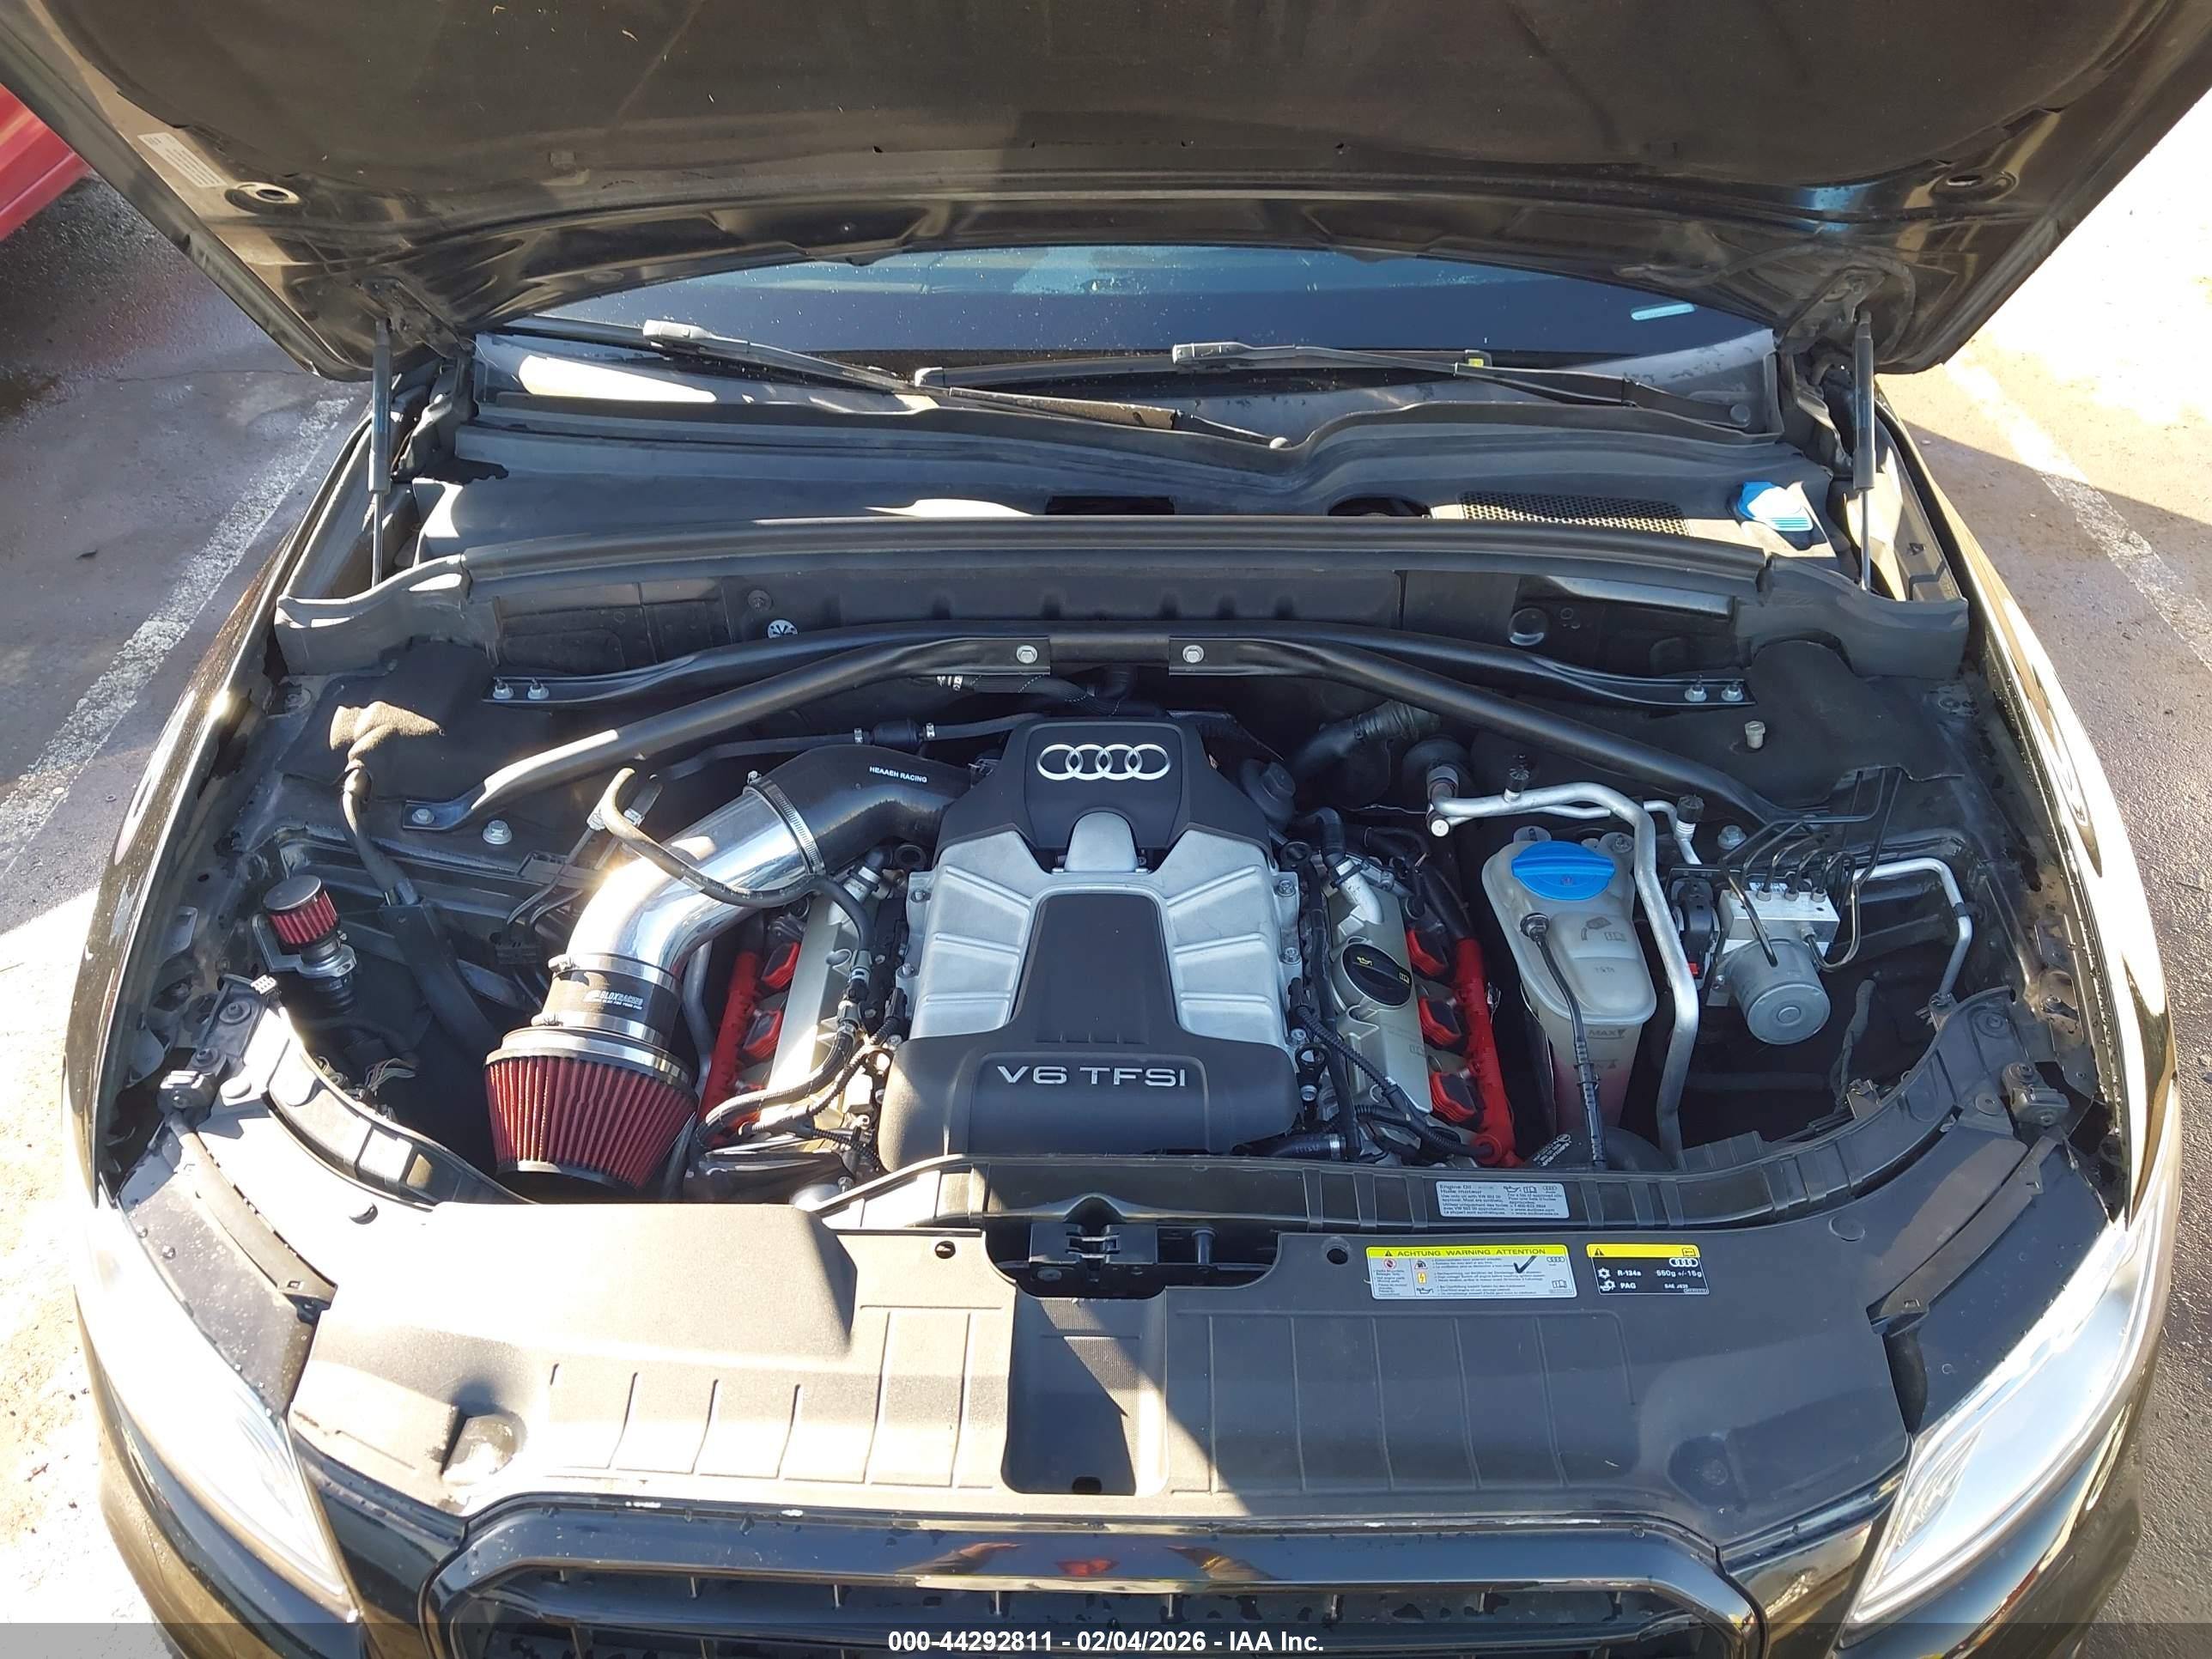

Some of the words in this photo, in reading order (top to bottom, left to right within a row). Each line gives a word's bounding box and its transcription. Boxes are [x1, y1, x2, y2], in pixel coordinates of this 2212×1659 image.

[900, 772, 927, 783] RACING
[997, 1066, 1067, 1085] V6
[1079, 1066, 1186, 1087] TFSI
